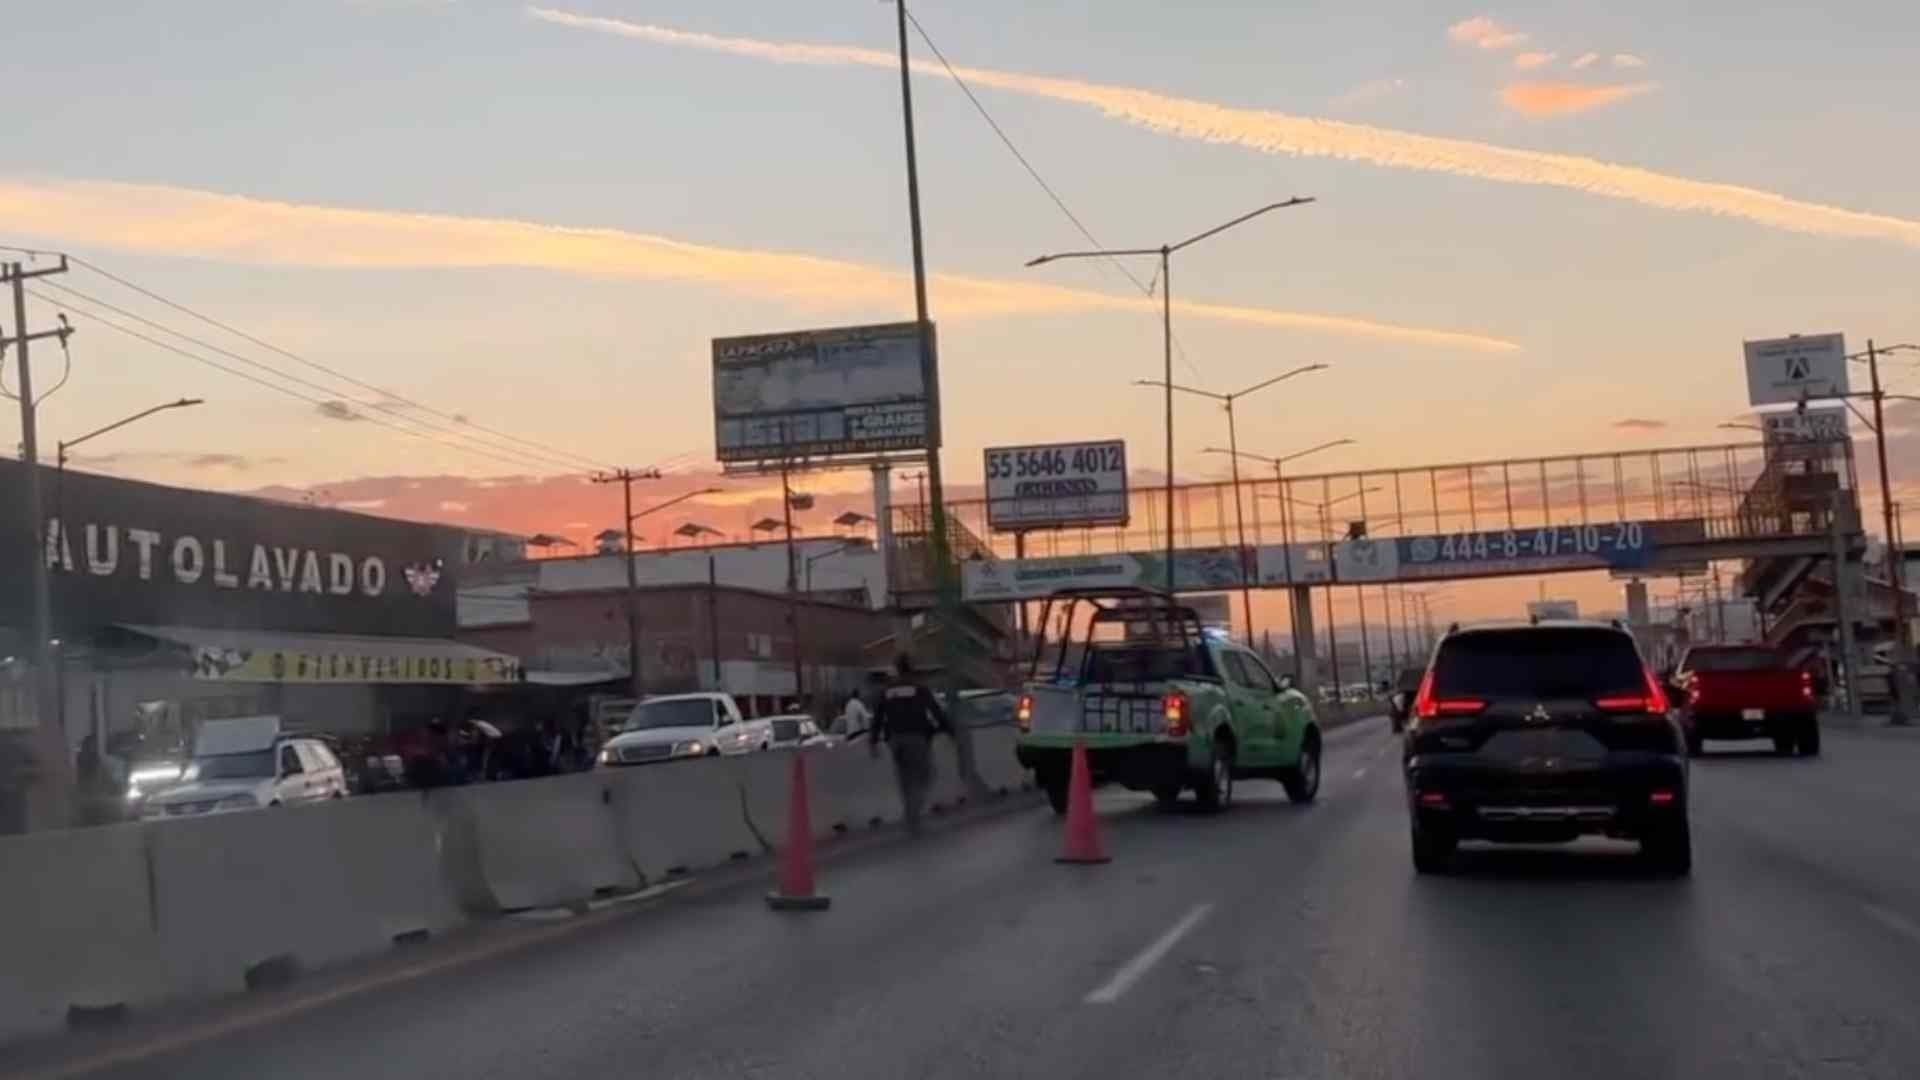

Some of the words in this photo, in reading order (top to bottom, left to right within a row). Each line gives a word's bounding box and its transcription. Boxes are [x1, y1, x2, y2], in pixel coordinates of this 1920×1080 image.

[988, 453, 1013, 479] 55
[1015, 448, 1067, 477] 5646
[1071, 446, 1121, 474] 4012
[45, 517, 387, 597] AUTOLAVADO
[1440, 522, 1643, 562] 444-8-47-10-20
[296, 653, 453, 680] BIENVENIDOS
